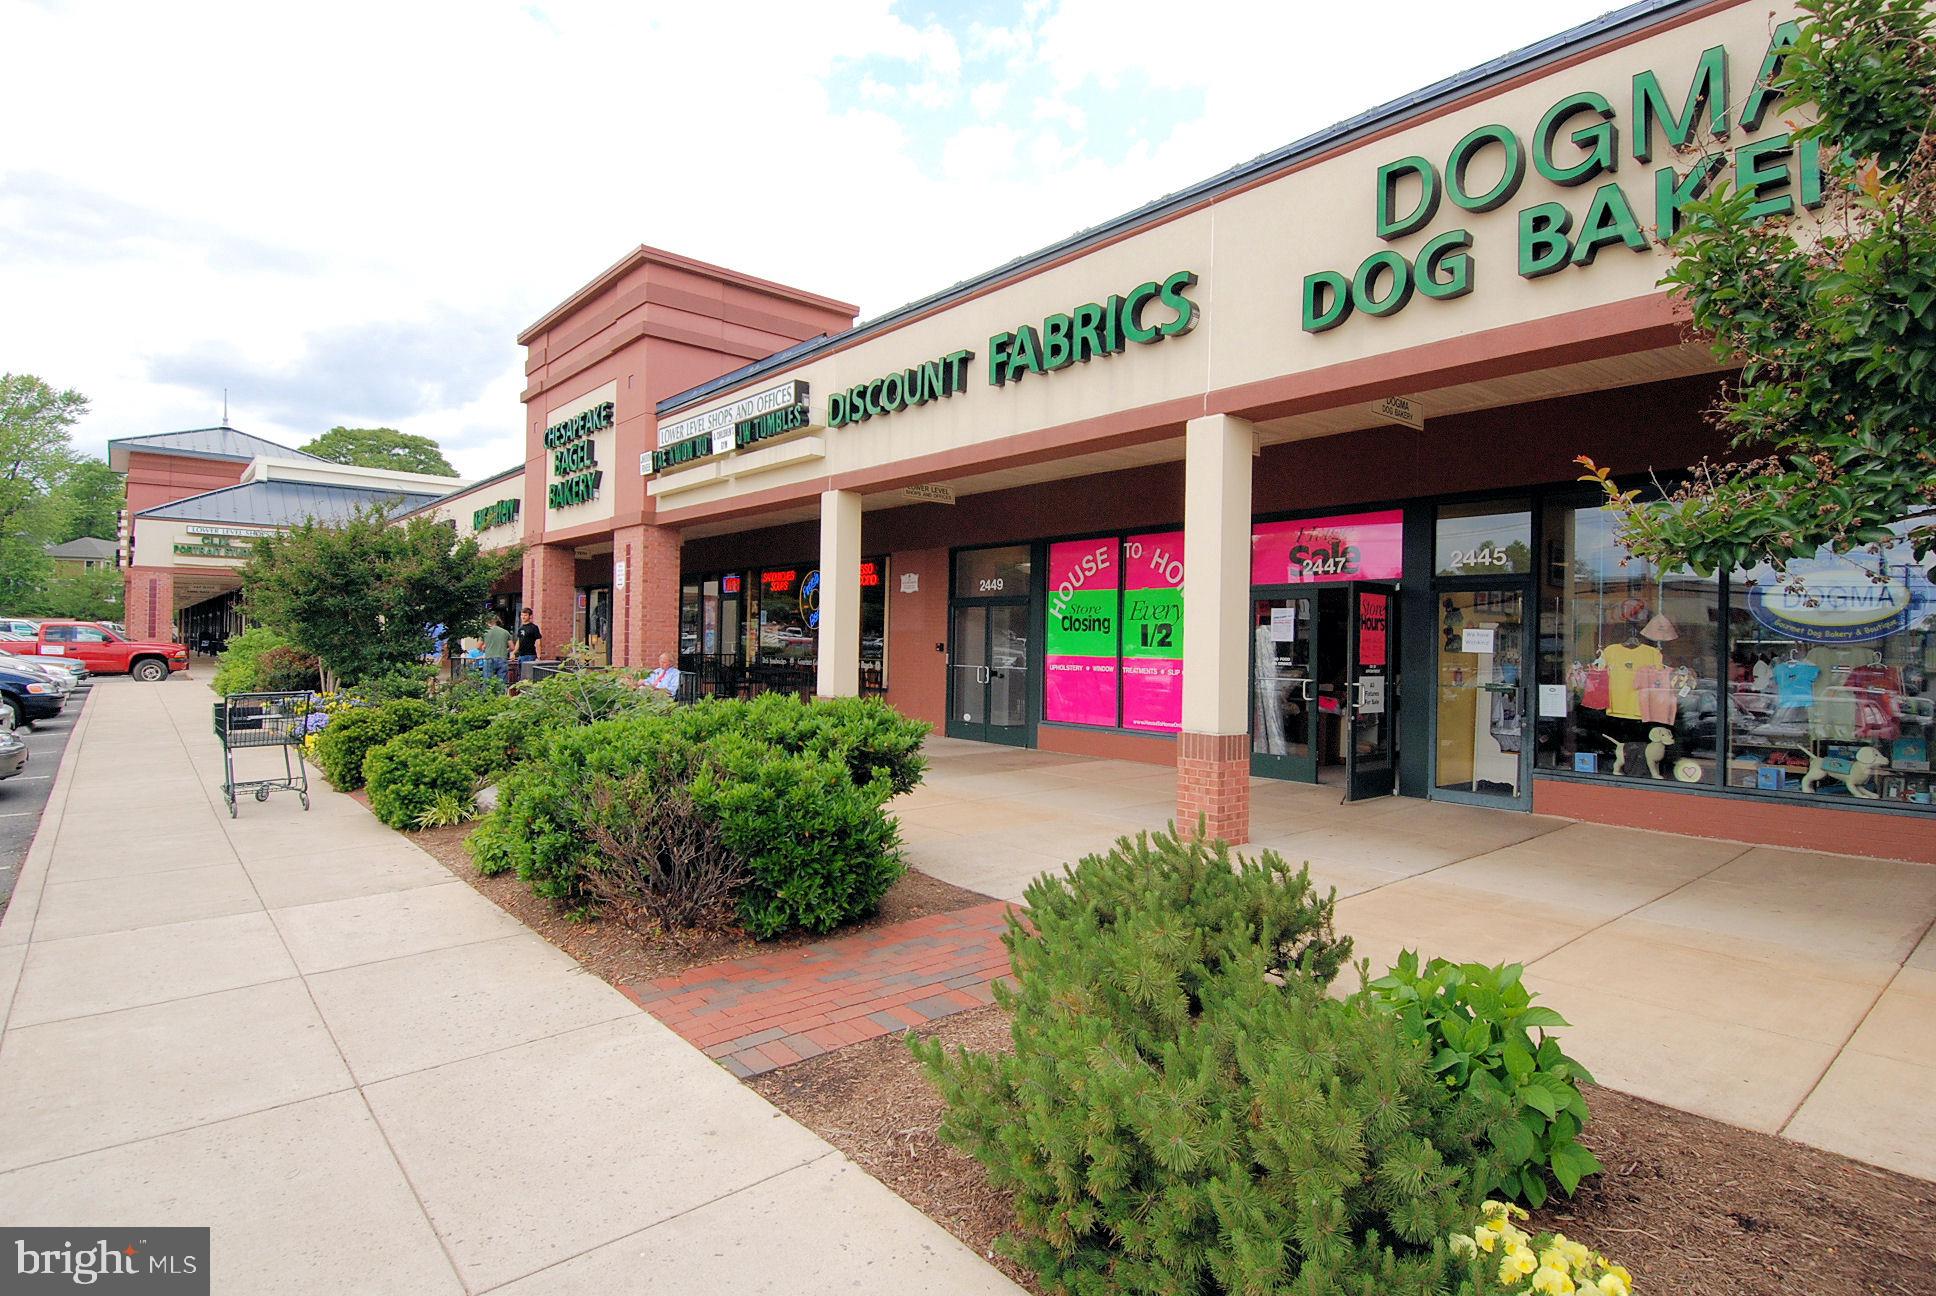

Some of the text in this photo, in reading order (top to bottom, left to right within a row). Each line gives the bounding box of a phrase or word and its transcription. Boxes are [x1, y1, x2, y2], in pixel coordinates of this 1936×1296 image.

[1302, 230, 1474, 334] DOG
[828, 271, 1199, 427] DISCOUNT FABRICS
[543, 401, 613, 449] CHESAPEAKE
[660, 386, 792, 445] LOWER LEVEL SHOPS AND OFFICES
[754, 404, 802, 438] TUMBLES
[555, 439, 596, 476] BAGEL
[549, 470, 602, 510] BAKERY
[931, 487, 949, 495] LEVEL
[173, 543, 221, 556] PORTRAIT
[1289, 540, 1361, 577] Sale
[1450, 547, 1507, 568] 2445
[1302, 557, 1346, 575] 2447
[980, 578, 1004, 591] 2449
[1049, 542, 1184, 620] HOUSE TO HO
[1070, 603, 1102, 615] Store
[1360, 600, 1386, 616] Store
[1783, 585, 1895, 609] DOGMA
[1061, 615, 1111, 635] Closing
[1129, 600, 1184, 627] Every
[1360, 616, 1386, 632] Hours
[1140, 622, 1173, 648] 1/2
[1774, 619, 1805, 635] Gourmet
[1807, 628, 1824, 639] Dog
[1824, 629, 1852, 639] Bakery
[1123, 666, 1158, 675] TREATMENTS
[1167, 668, 1181, 676] SLIP
